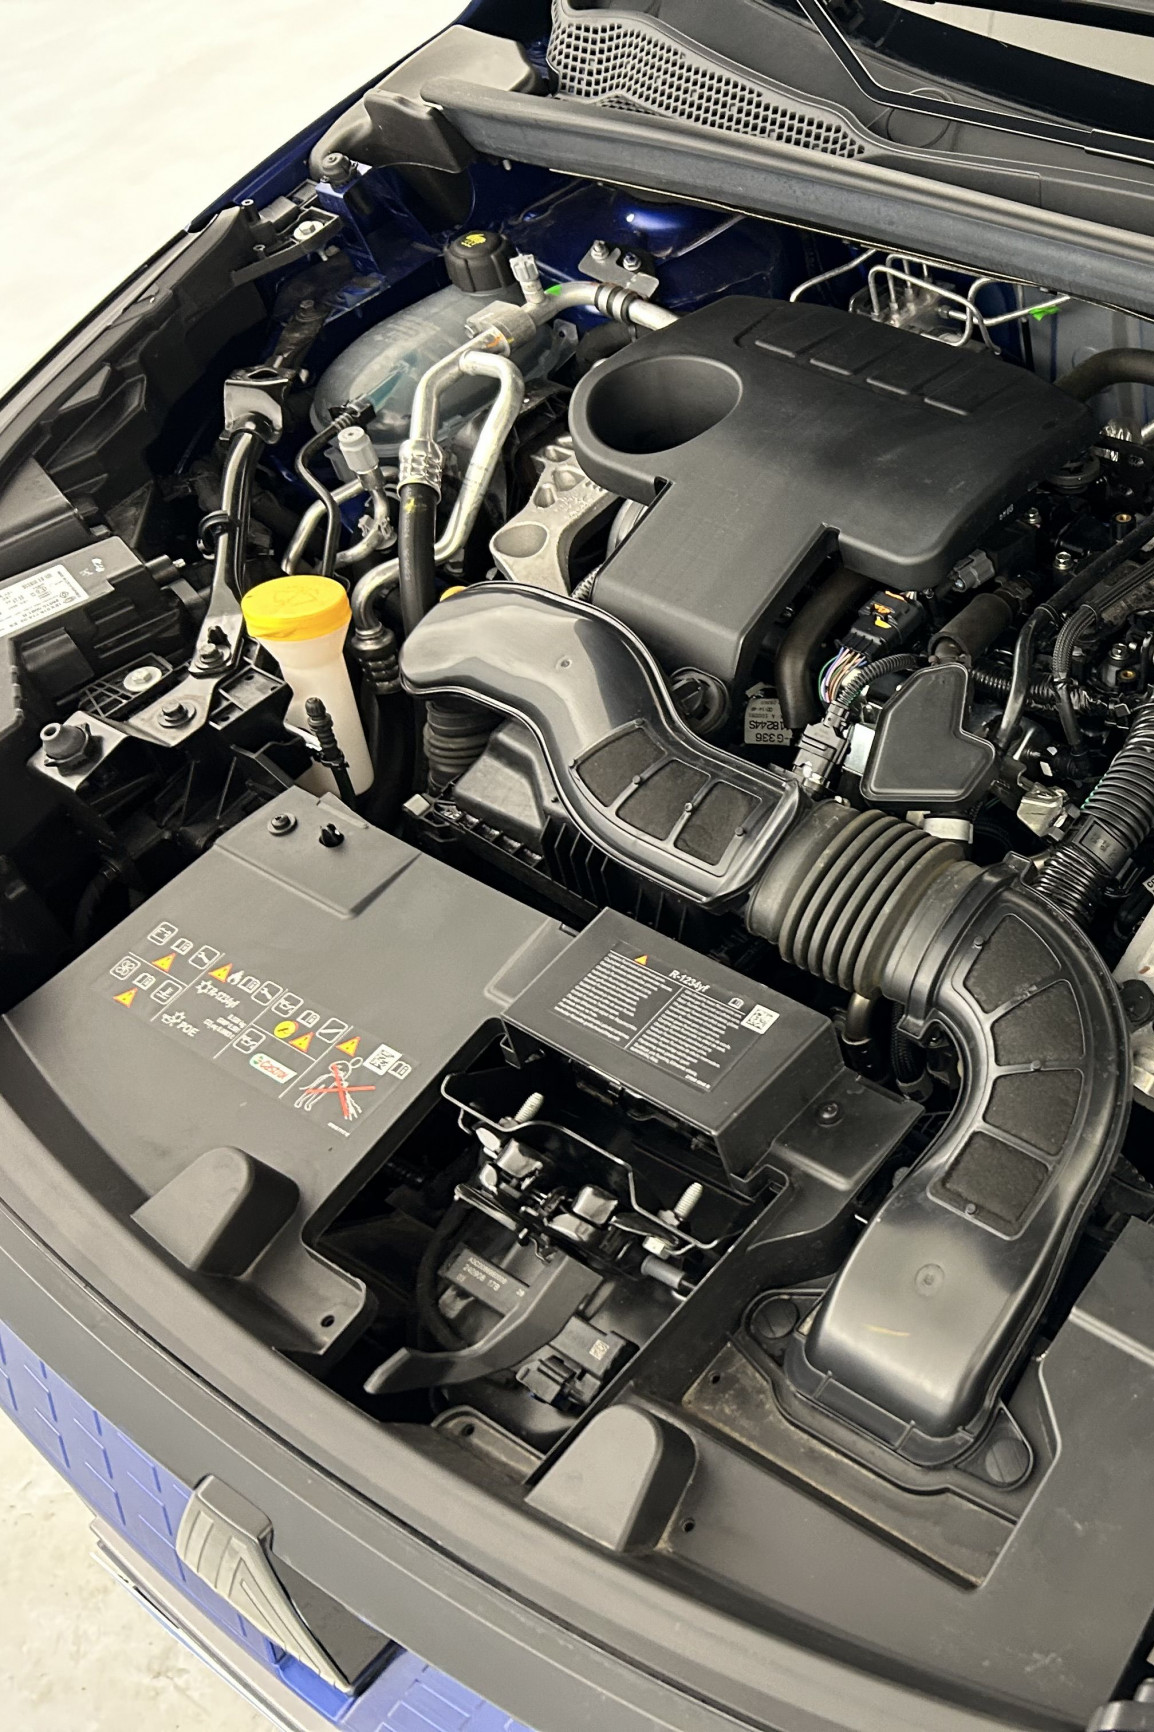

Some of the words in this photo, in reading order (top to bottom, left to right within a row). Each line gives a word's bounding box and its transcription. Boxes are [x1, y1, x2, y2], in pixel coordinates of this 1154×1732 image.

[668, 969, 711, 992] R-1234yf
[179, 1021, 200, 1039] POE
[260, 1060, 288, 1080] Castrol
